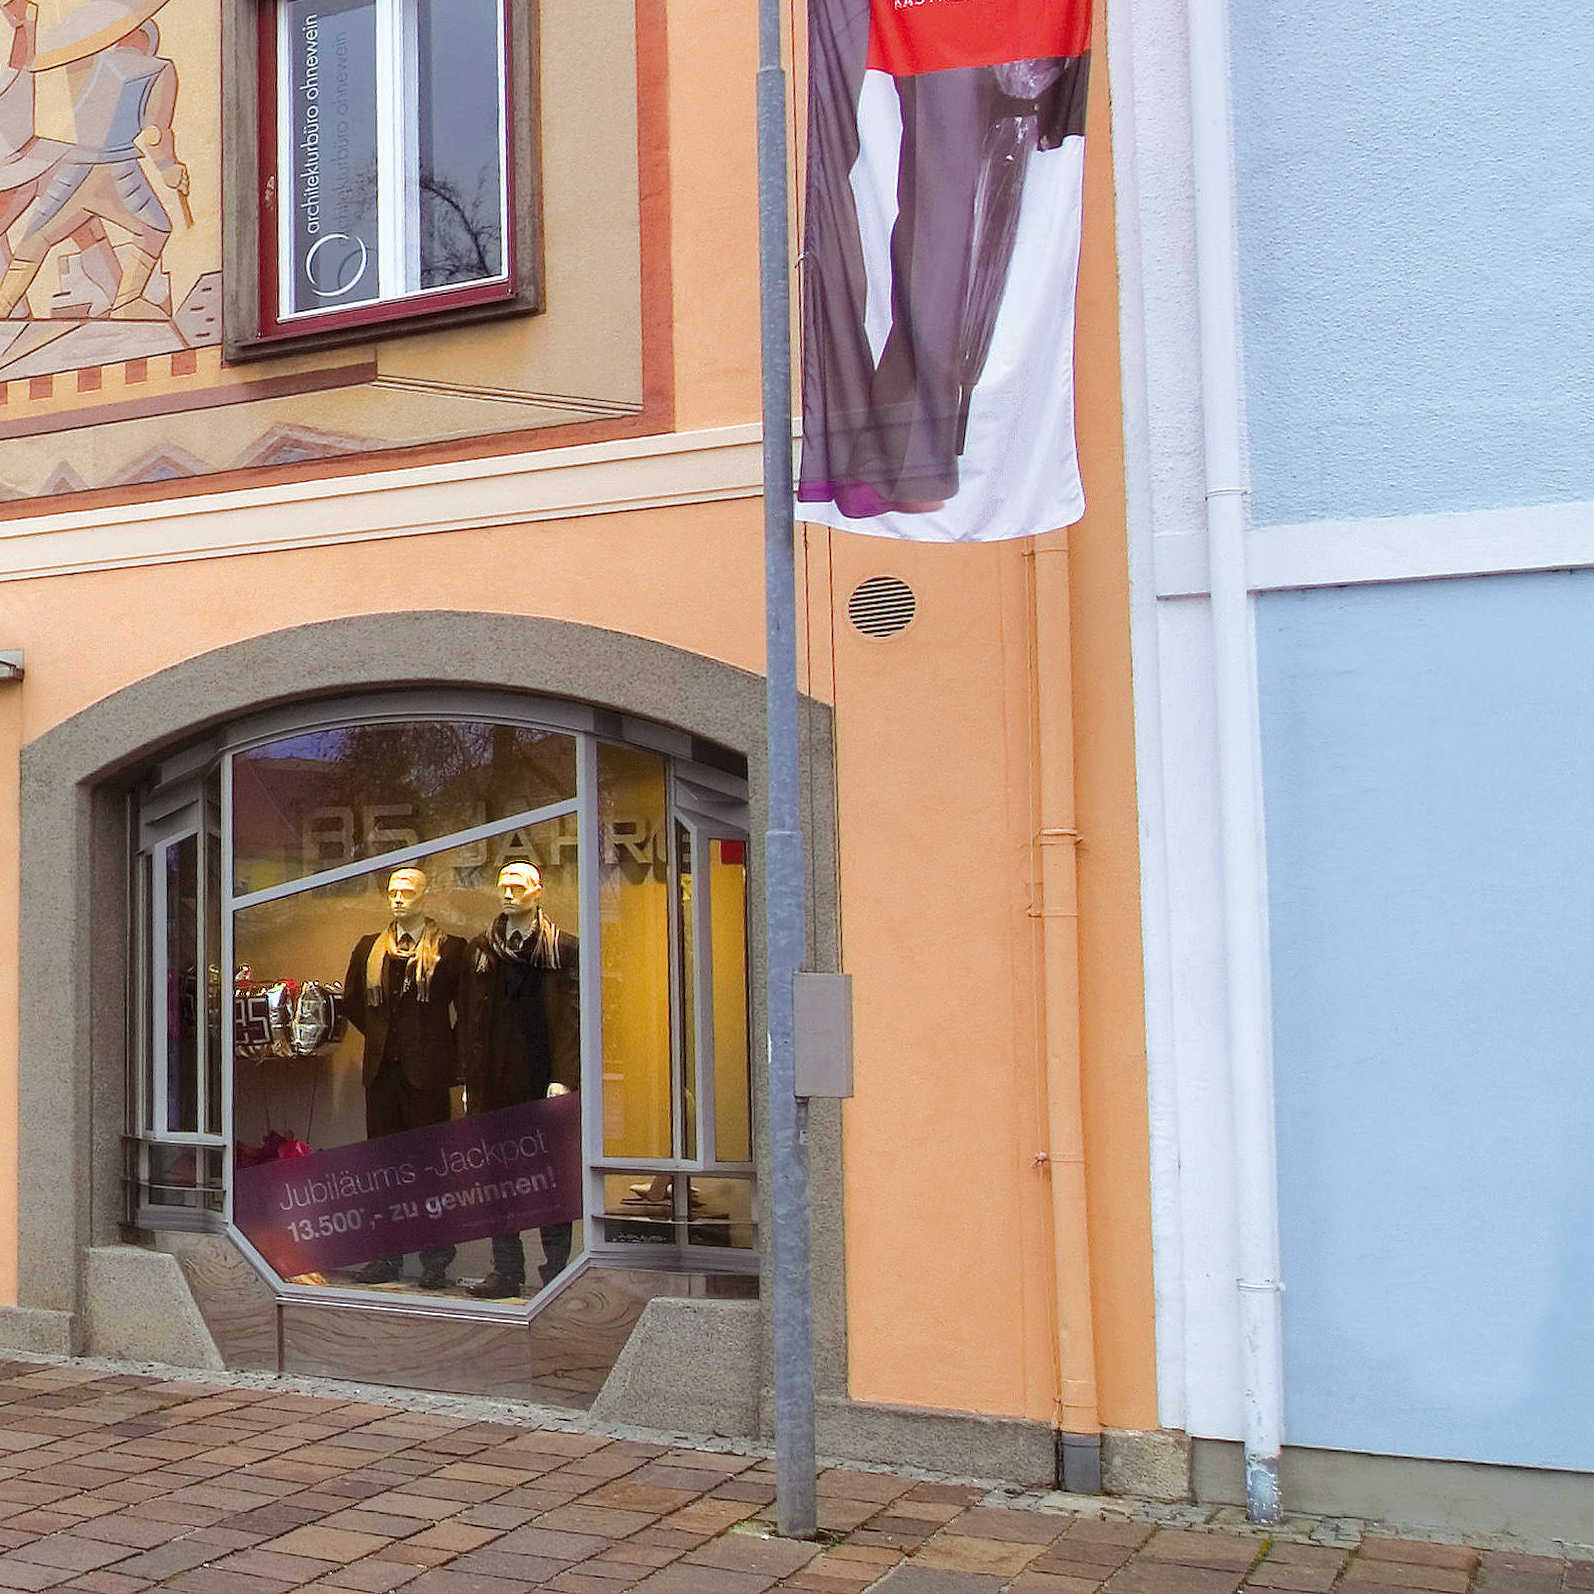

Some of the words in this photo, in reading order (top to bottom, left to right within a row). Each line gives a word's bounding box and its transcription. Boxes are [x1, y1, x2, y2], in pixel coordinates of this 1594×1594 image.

[299, 13, 319, 101] ohnewein
[299, 105, 320, 234] architekturbüro
[280, 1165, 416, 1211] Jubiläums
[389, 1201, 419, 1222] zu
[425, 1165, 557, 1219] gewinnen!
